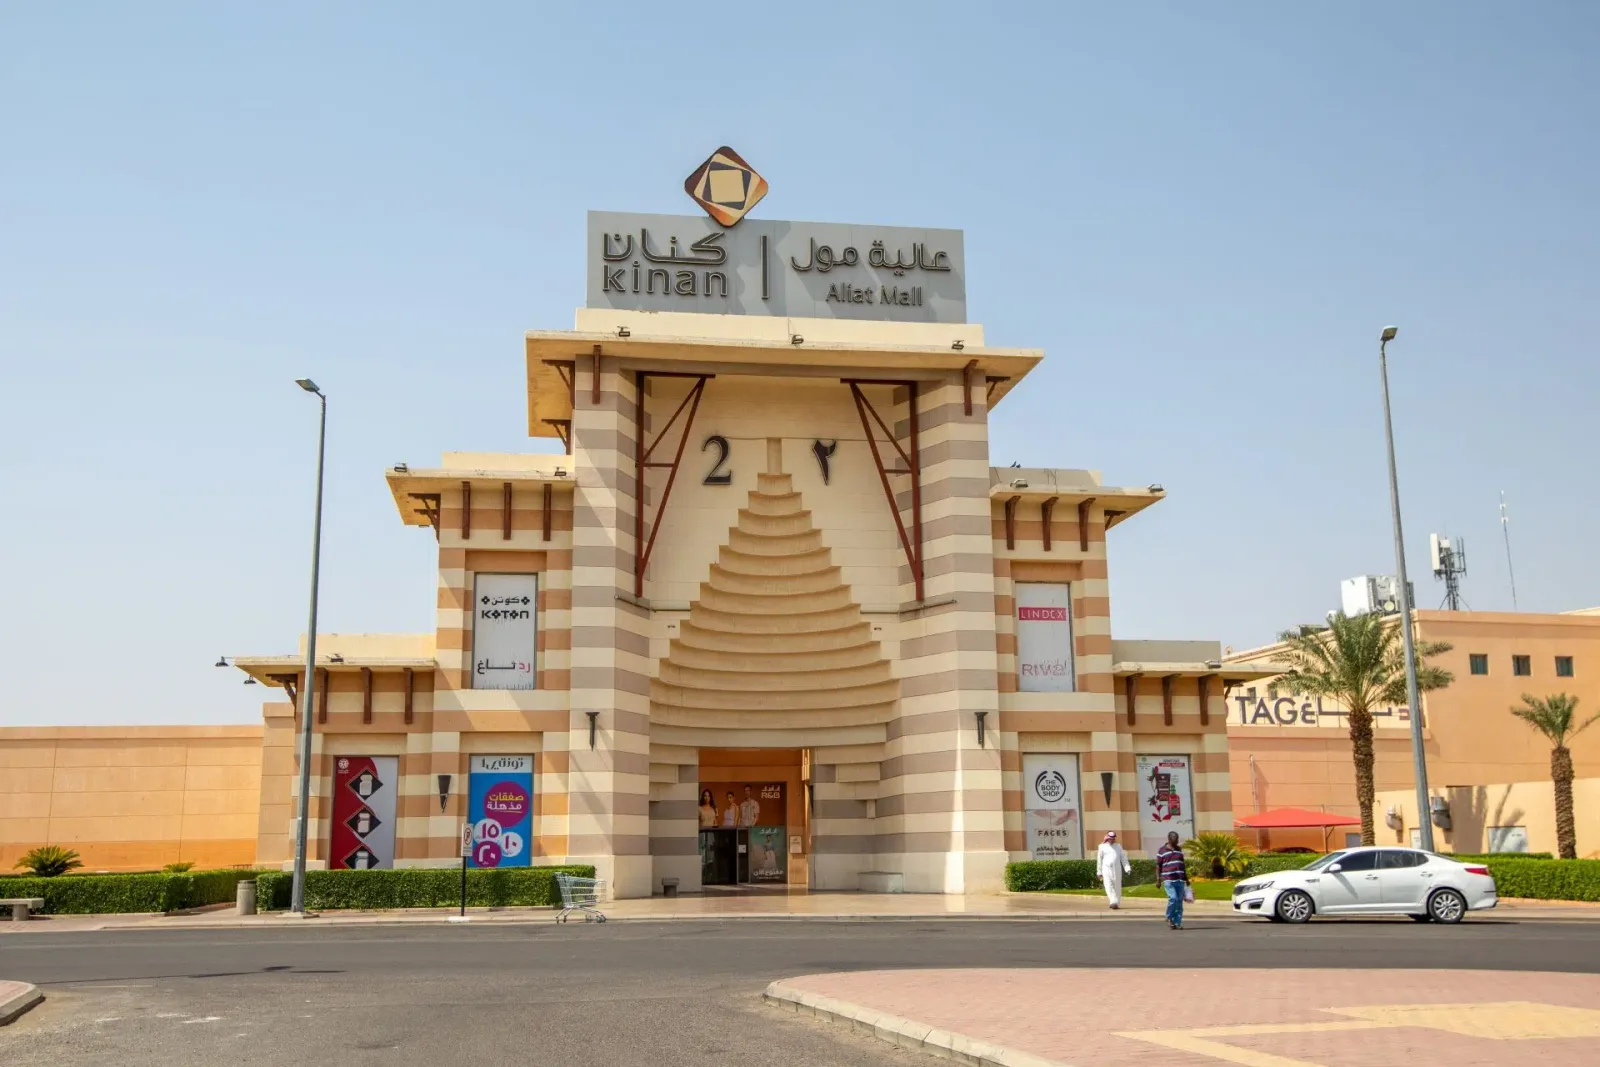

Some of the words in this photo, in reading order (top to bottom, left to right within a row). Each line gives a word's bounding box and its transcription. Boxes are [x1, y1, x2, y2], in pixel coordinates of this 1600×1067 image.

[602, 228, 728, 266] كنان
[791, 236, 859, 272] مول
[868, 239, 951, 276] عالية
[602, 260, 728, 297] kinan
[825, 282, 873, 306] Aliat
[879, 284, 922, 307] Mall
[701, 435, 732, 486] 2
[1021, 610, 1064, 619] LINDEX
[487, 800, 522, 811] مذهلة
[489, 792, 524, 801] صفقات
